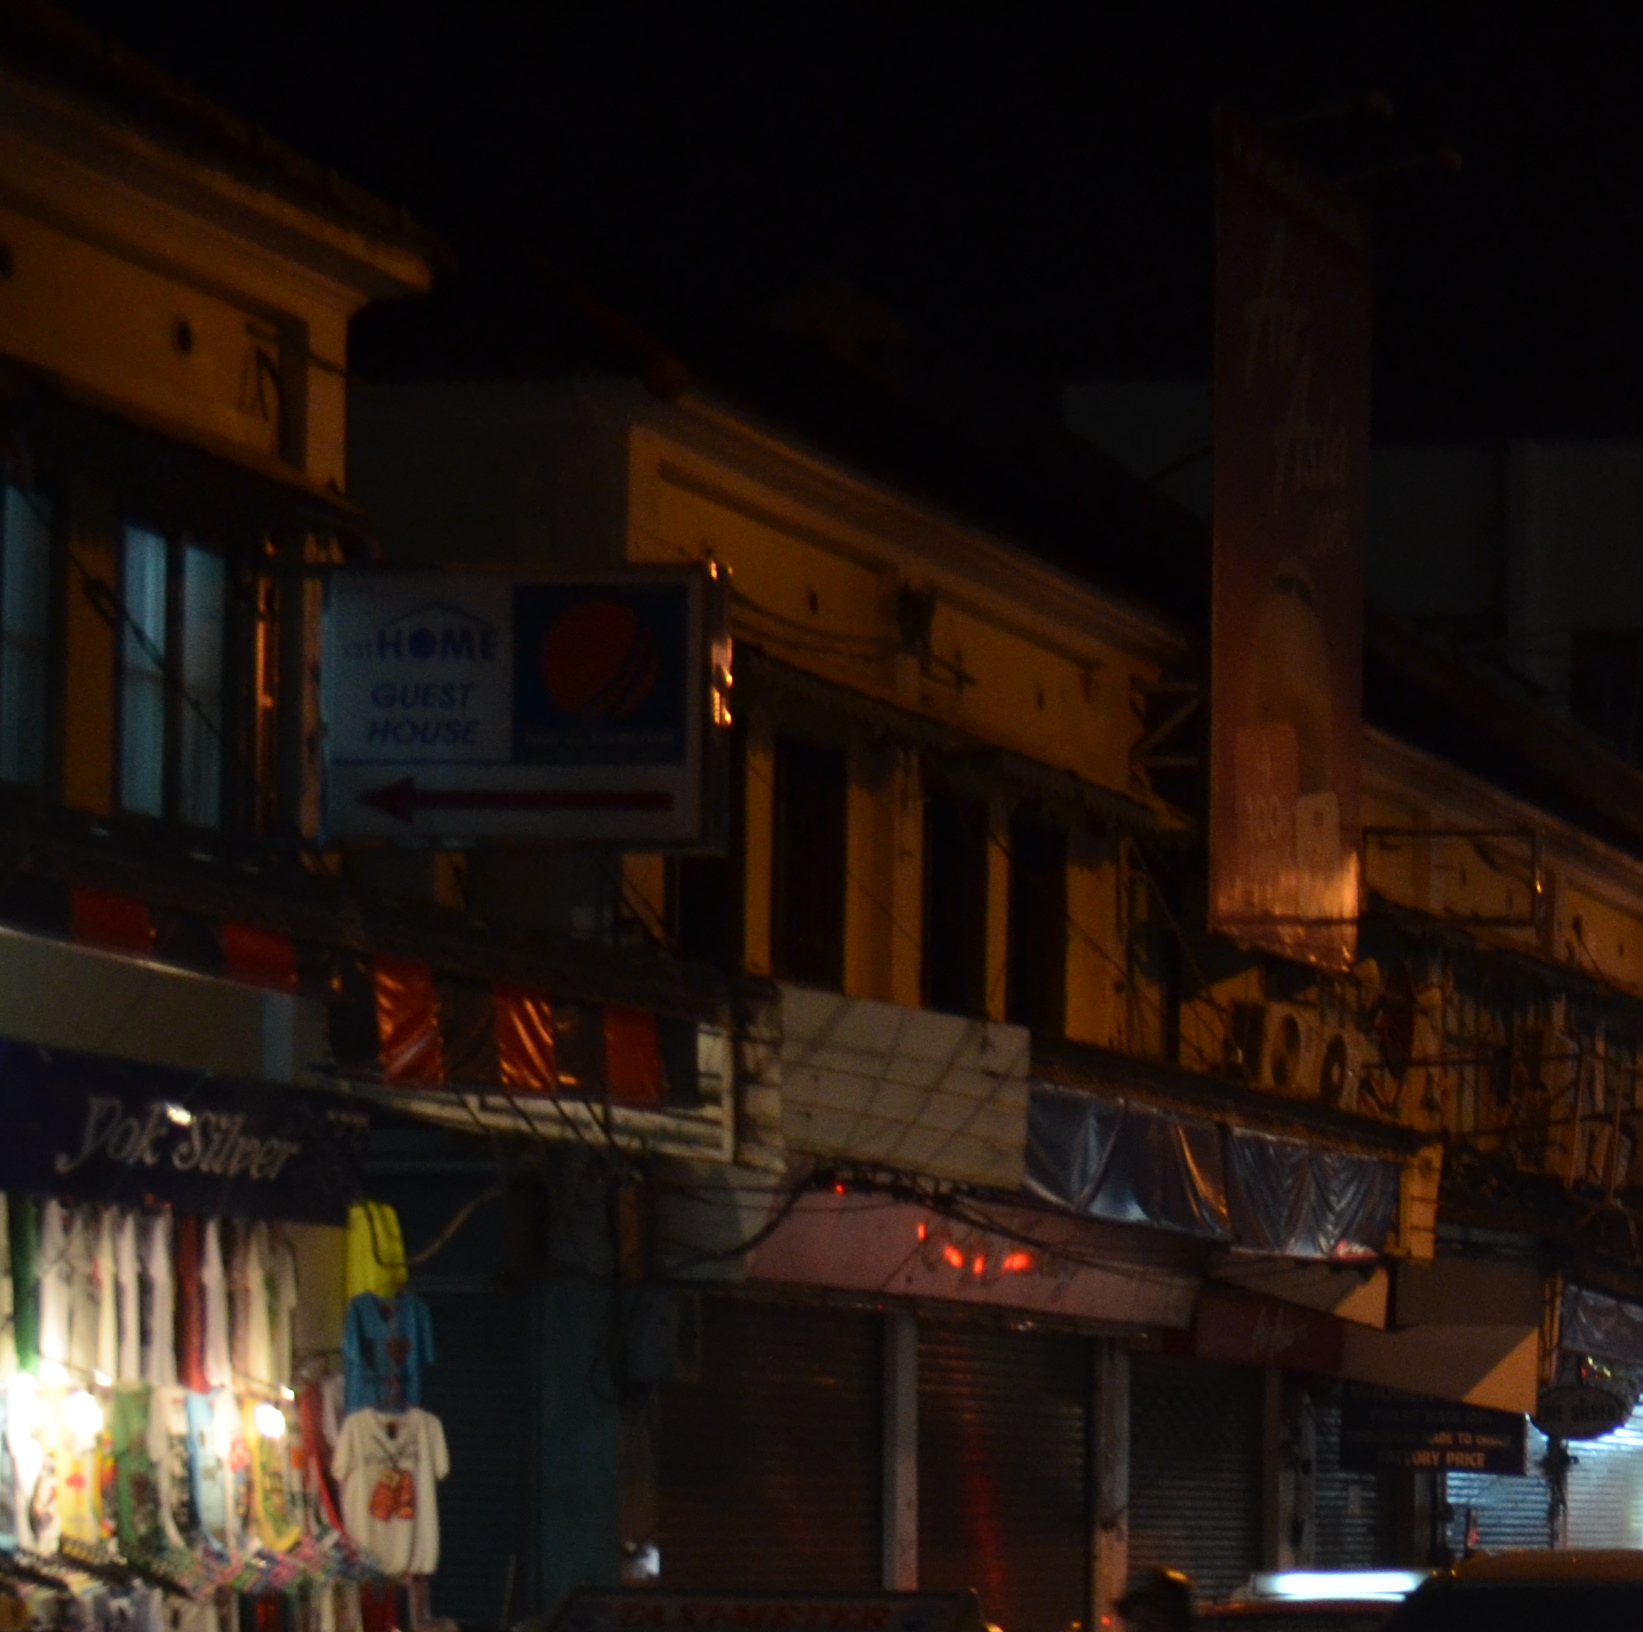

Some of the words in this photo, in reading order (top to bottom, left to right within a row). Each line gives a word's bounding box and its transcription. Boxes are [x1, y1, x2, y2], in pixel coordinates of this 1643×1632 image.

[370, 682, 474, 709] GUEST
[367, 719, 481, 744] HOUSE
[171, 1110, 300, 1181] Silver
[1445, 1451, 1487, 1468] PRICE
